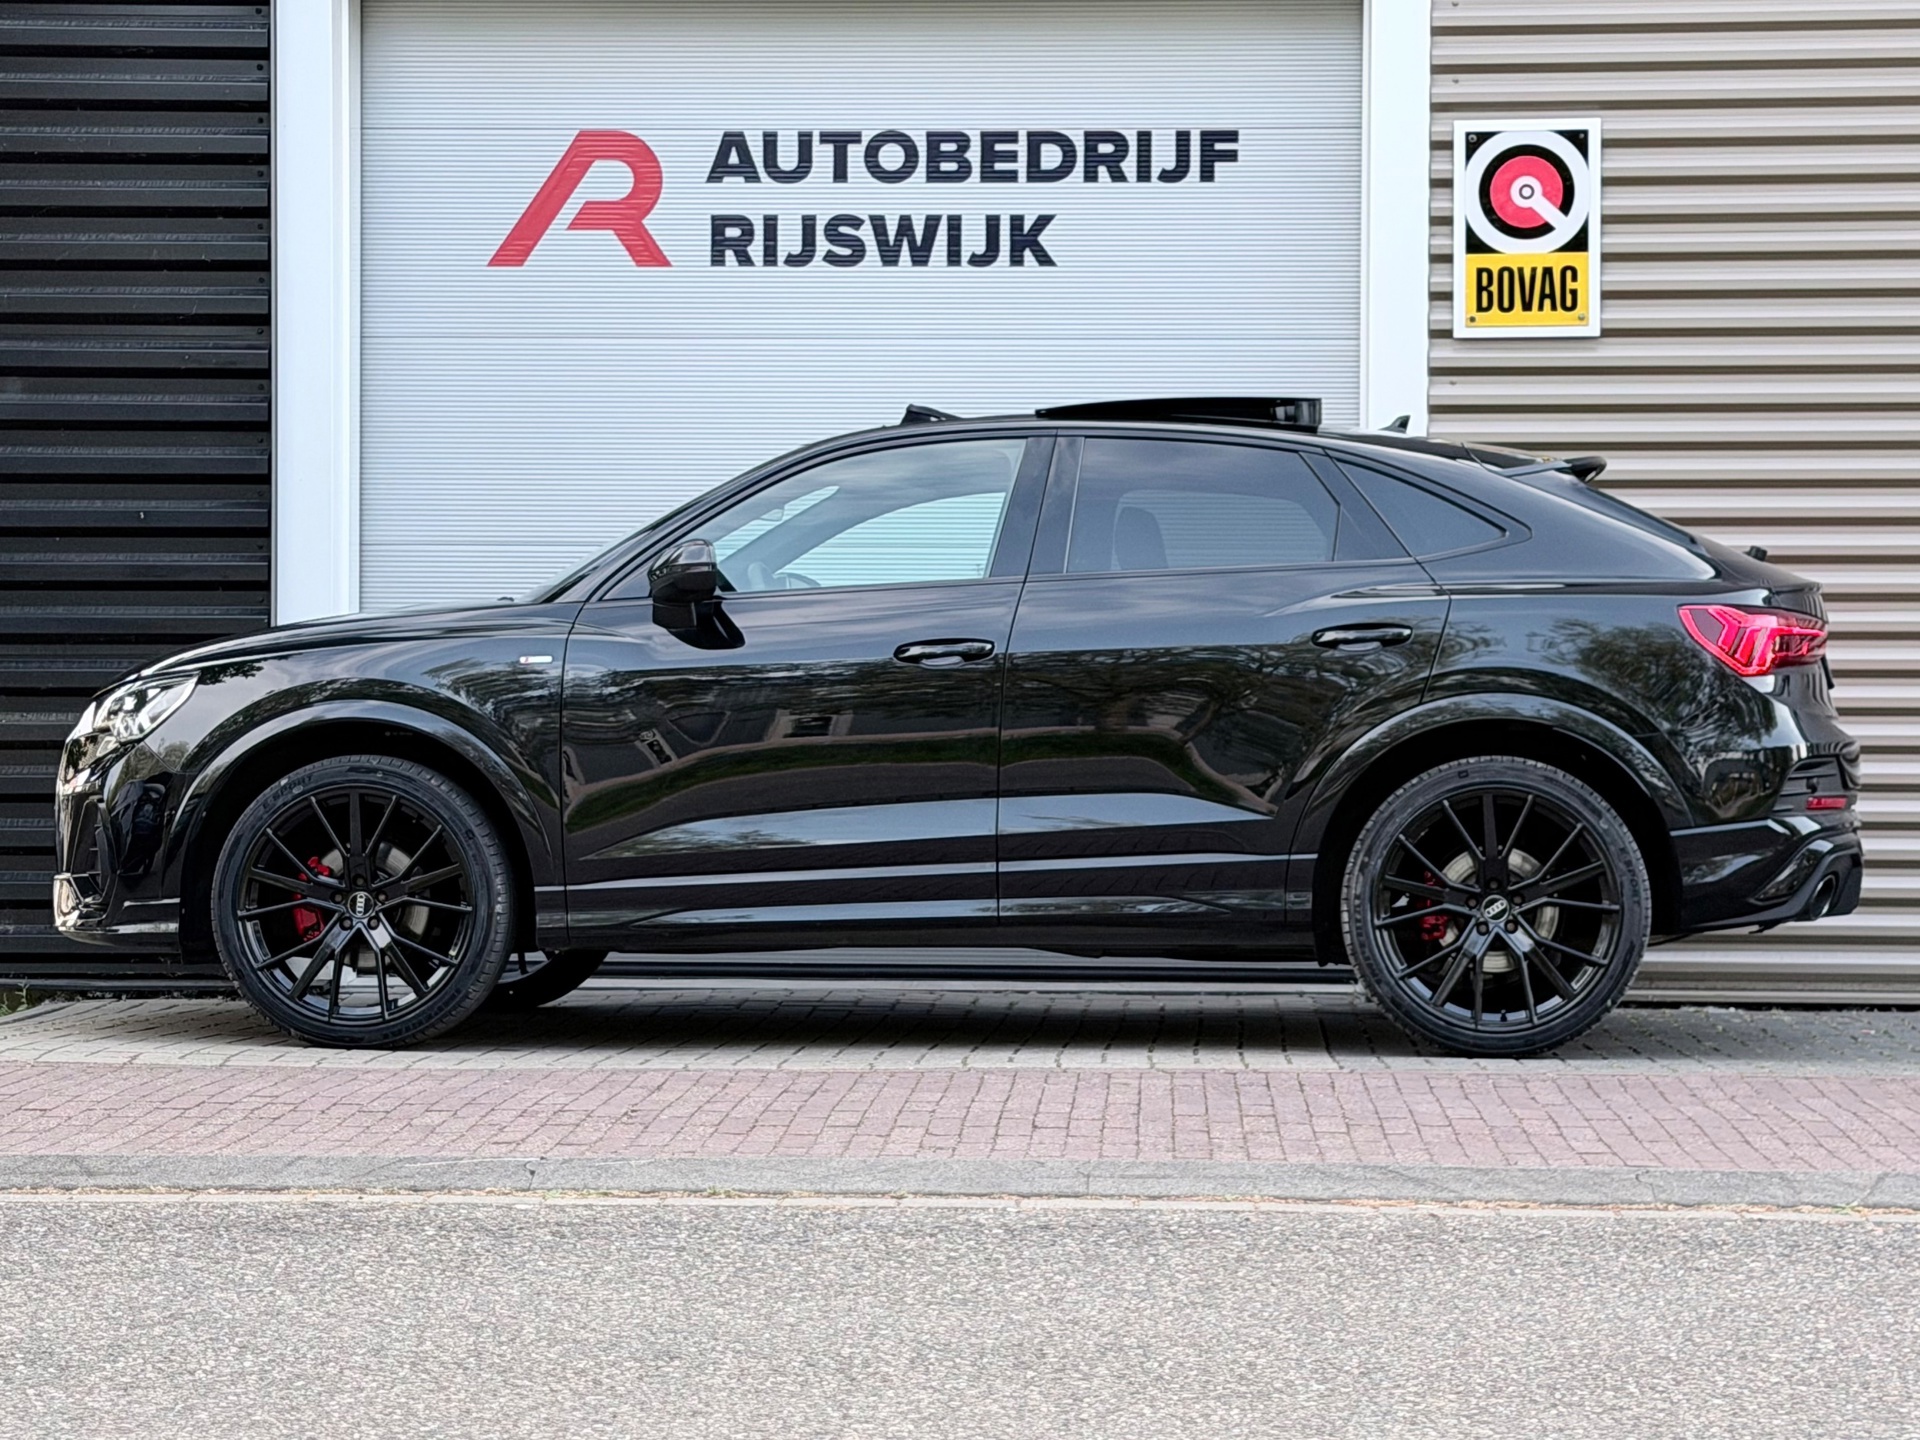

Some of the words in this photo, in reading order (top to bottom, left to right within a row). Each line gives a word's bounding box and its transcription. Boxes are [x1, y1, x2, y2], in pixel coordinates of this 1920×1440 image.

[706, 129, 1240, 184] AUTOBEDRIJF
[710, 214, 1058, 267] RIJSWIJK
[1475, 265, 1579, 313] BOVAG
